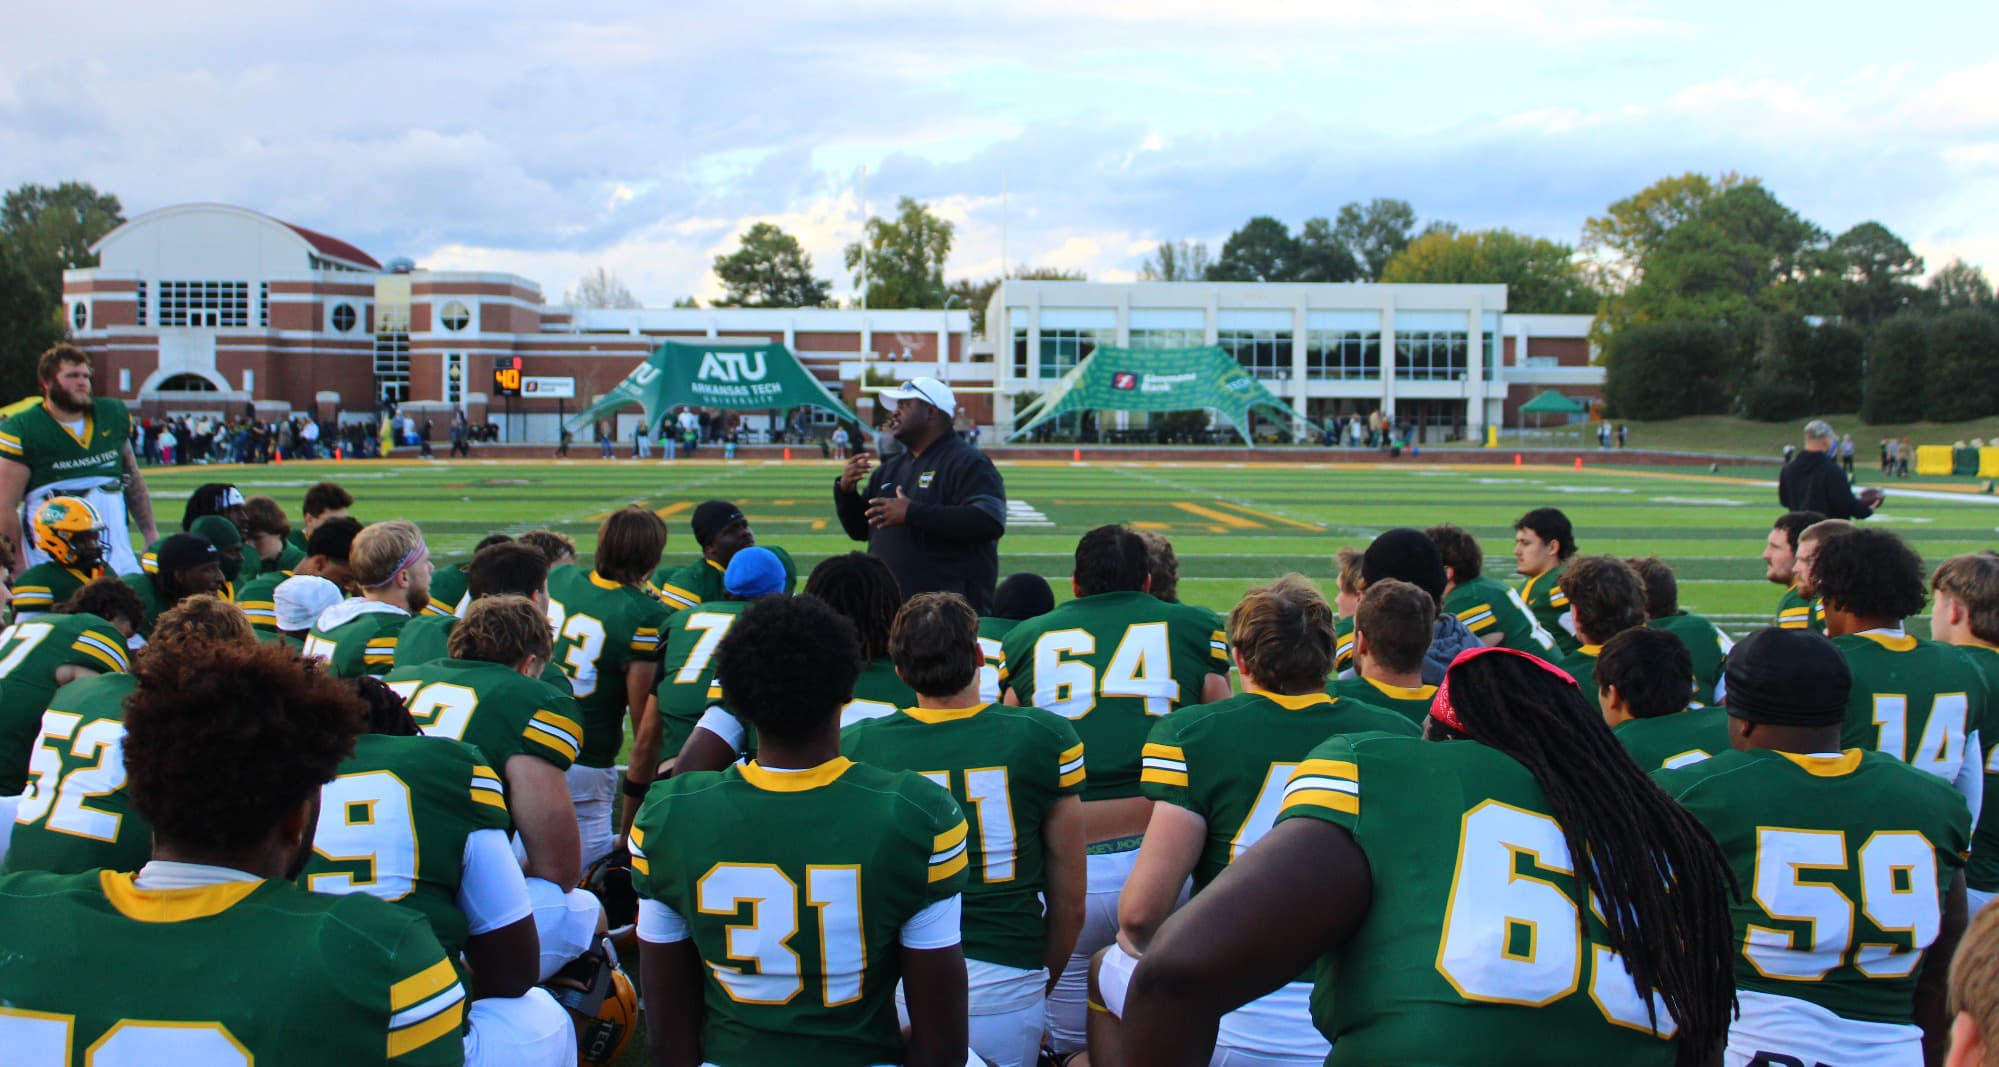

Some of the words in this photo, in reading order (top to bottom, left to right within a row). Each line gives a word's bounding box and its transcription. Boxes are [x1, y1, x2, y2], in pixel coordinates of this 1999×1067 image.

[495, 369, 520, 390] 40
[691, 382, 748, 397] ARKANSAS
[750, 382, 782, 395] TECH
[698, 352, 768, 382] ATU
[702, 395, 774, 405] UNIVERSITY
[52, 455, 101, 470] ARKANSAS
[101, 448, 120, 462] TECH
[0, 622, 54, 680] 7
[1032, 622, 1180, 720] 64
[1872, 692, 1968, 785] 14
[15, 709, 128, 843] 52
[1742, 825, 1941, 981] 59
[696, 861, 868, 1008] 31
